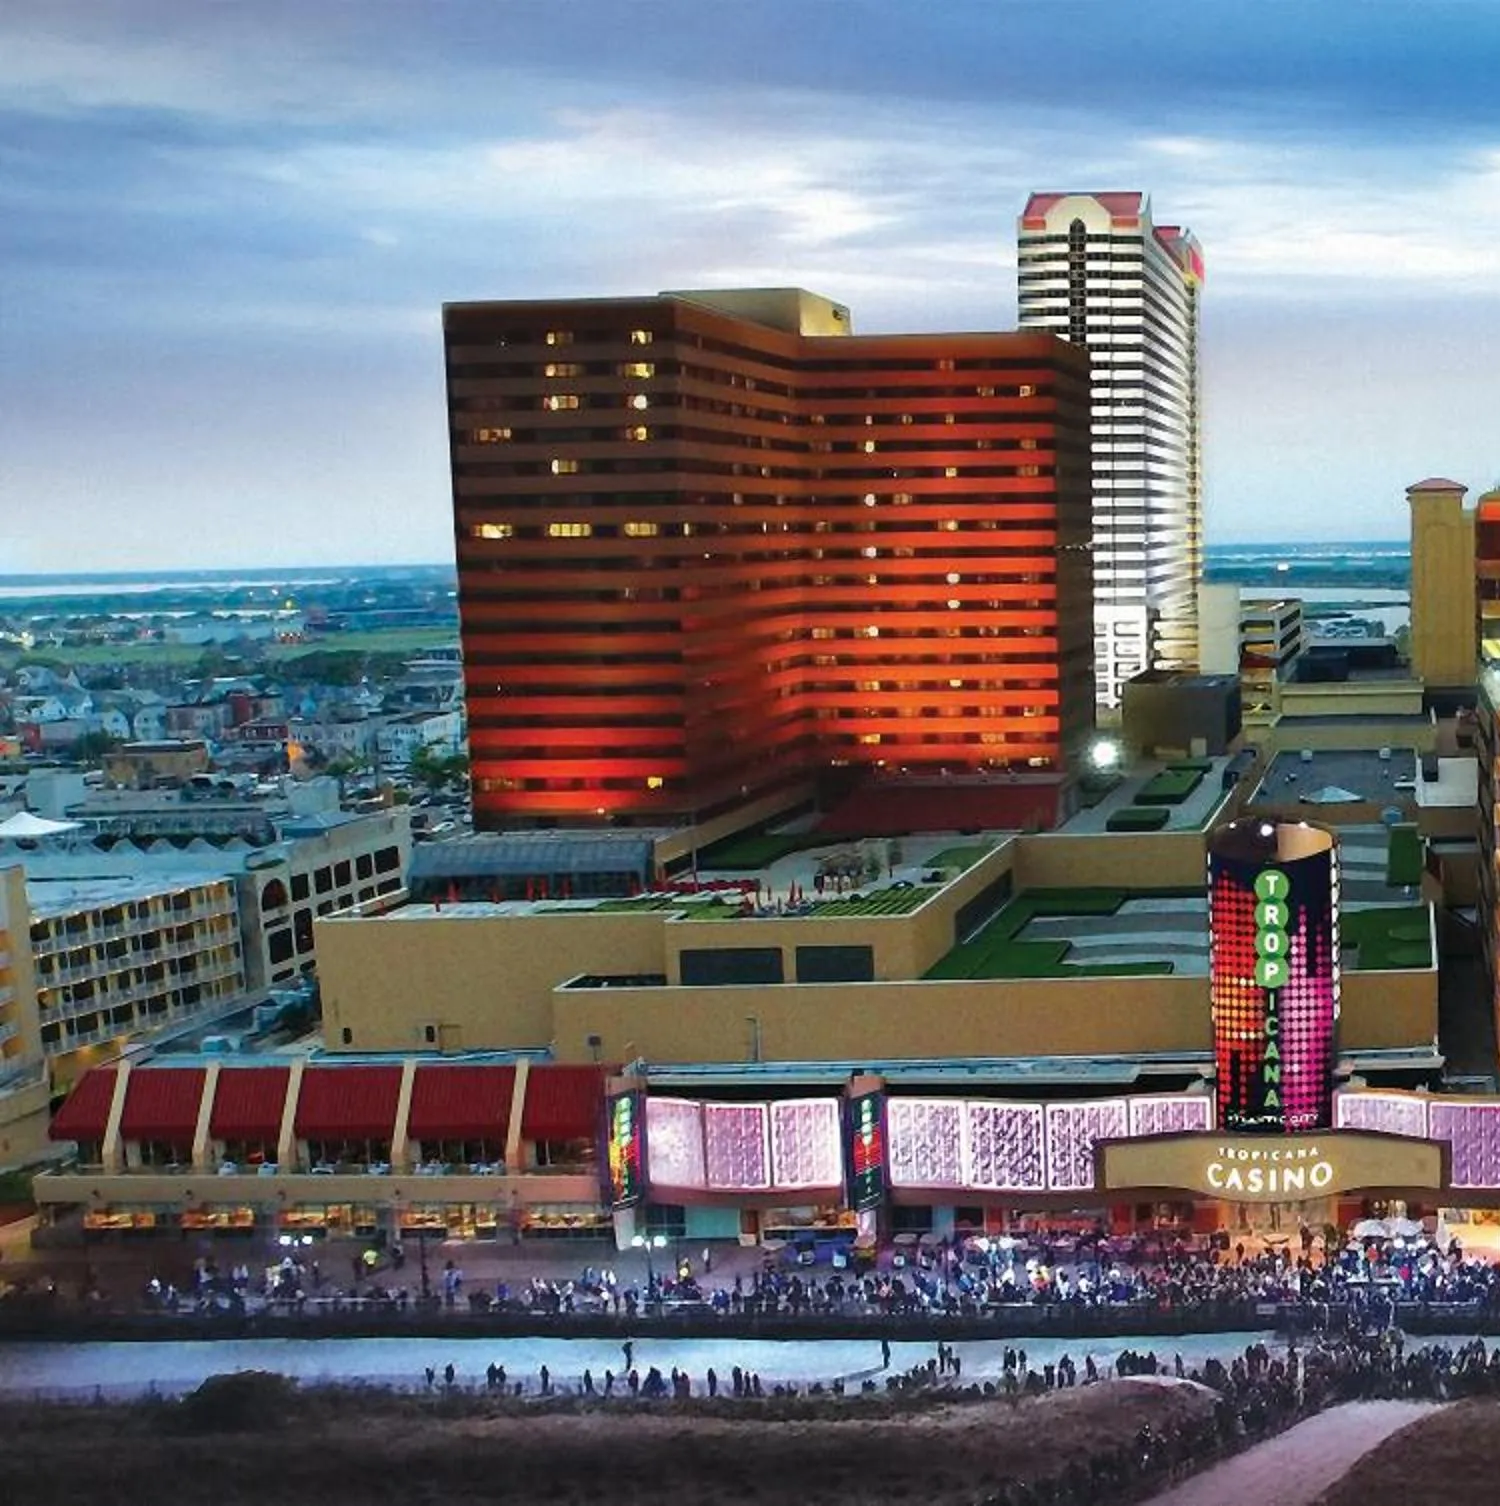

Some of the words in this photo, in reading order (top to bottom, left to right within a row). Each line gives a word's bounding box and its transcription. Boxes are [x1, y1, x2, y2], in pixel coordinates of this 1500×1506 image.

[1263, 875, 1281, 1108] TROPICANA
[1218, 1146, 1320, 1161] TROPICANA
[1207, 1161, 1333, 1193] CASINO
